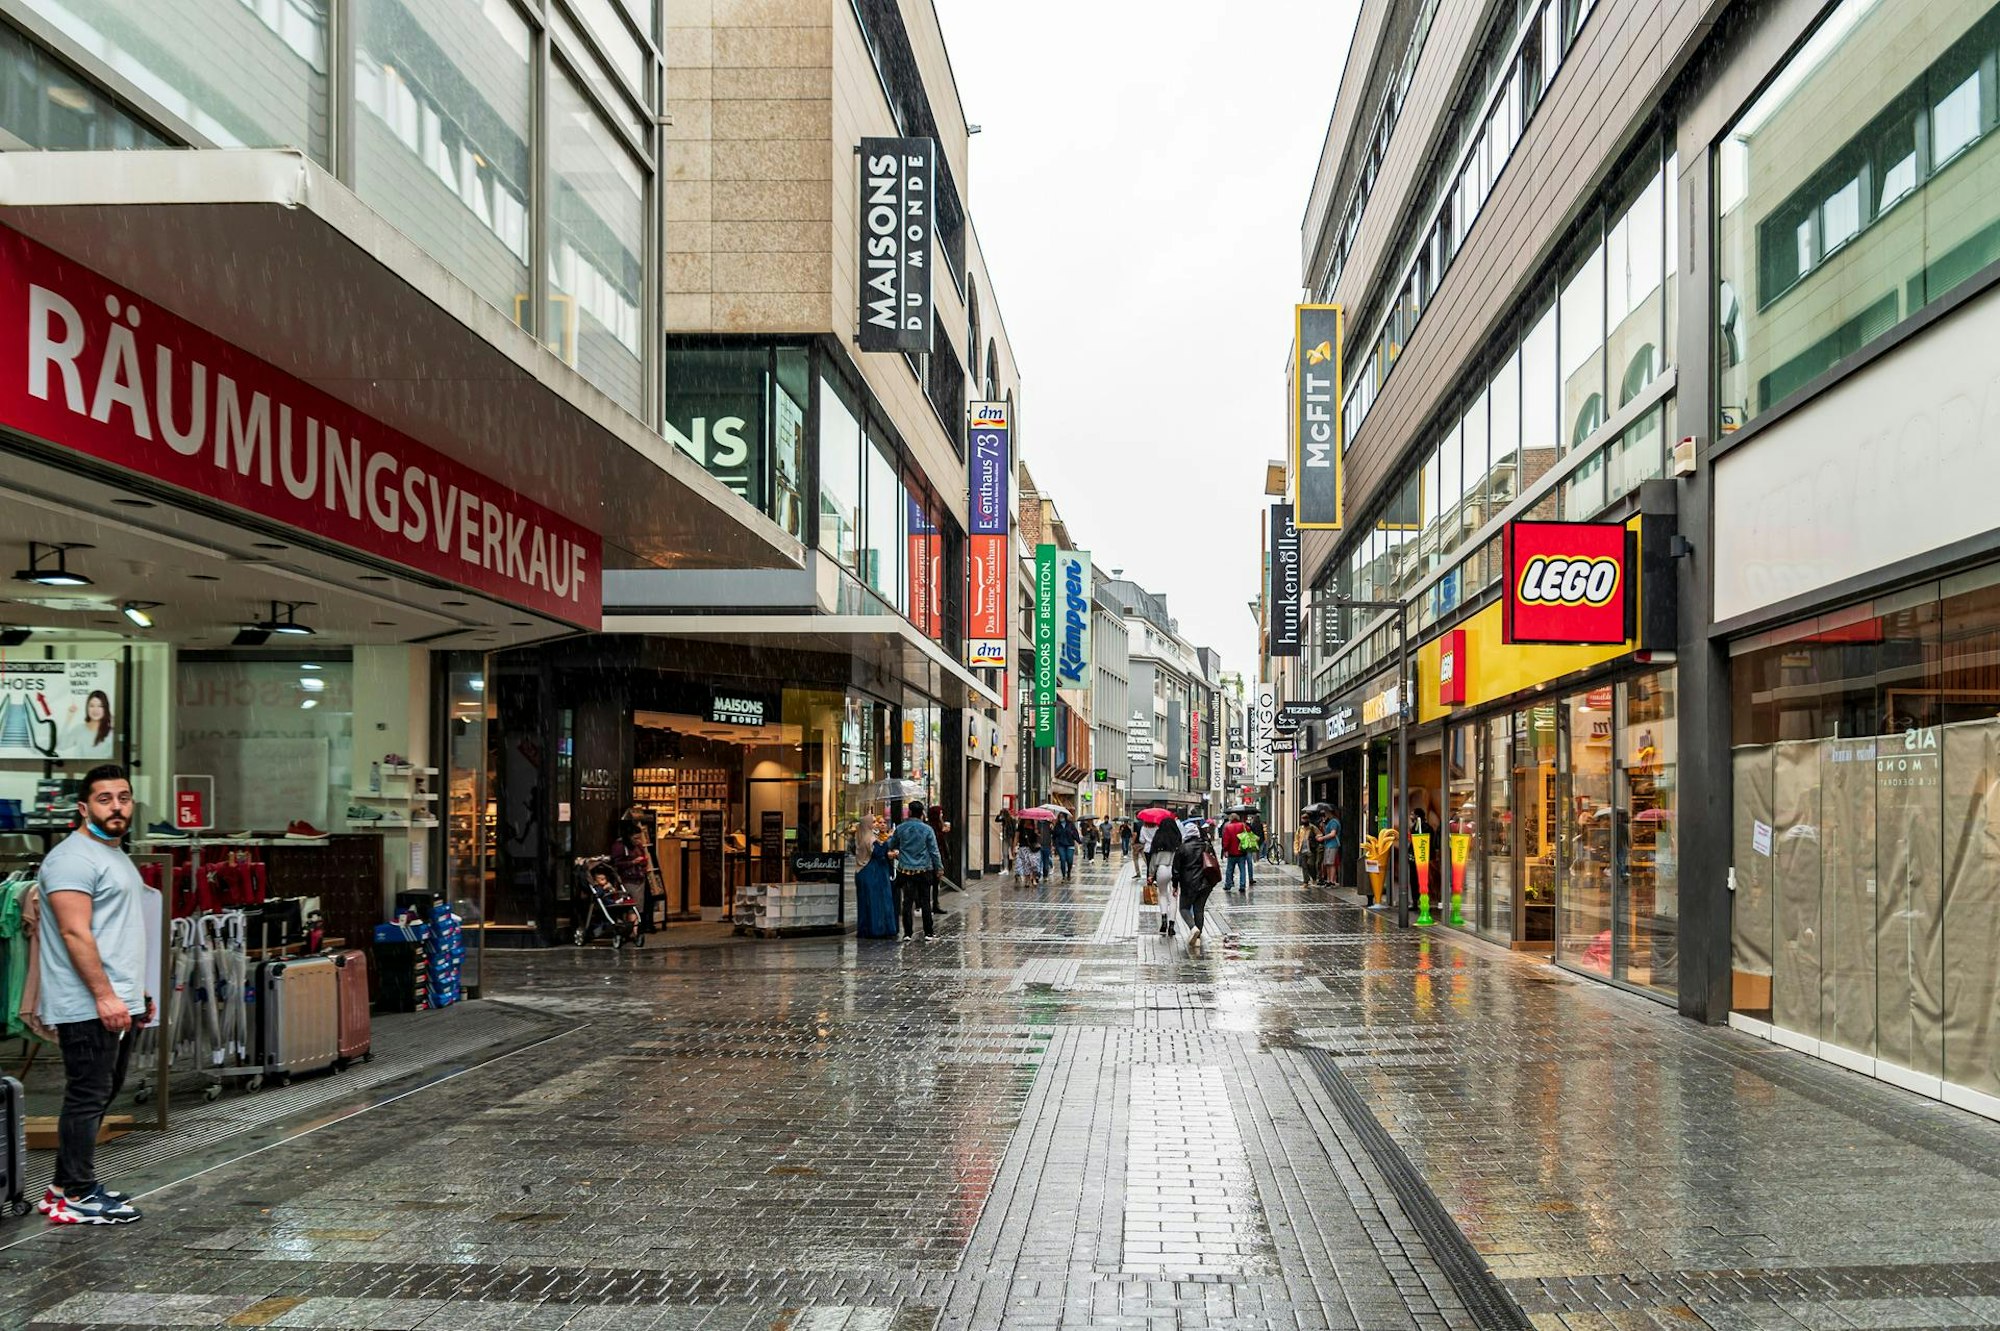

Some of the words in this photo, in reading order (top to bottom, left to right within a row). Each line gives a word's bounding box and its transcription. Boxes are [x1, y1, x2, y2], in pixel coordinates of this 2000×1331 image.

[907, 154, 923, 268] MONDE
[867, 153, 898, 330] MAISONS
[907, 292, 923, 330] DU
[978, 405, 1003, 420] dm
[27, 283, 587, 603] RÄUMUNGSVERKAUF
[977, 434, 999, 459] 73
[979, 460, 993, 529] Eventhaus
[985, 539, 996, 585] Steakhaus
[1277, 516, 1298, 643] hunkemöller
[1521, 558, 1618, 604] LEGO
[985, 587, 995, 613] kleine
[1040, 560, 1051, 618] BENETTON.
[985, 615, 995, 633] Das
[1040, 622, 1051, 638] OF
[1059, 559, 1087, 682] Kämpgen
[977, 642, 1001, 657] dm
[1040, 643, 1051, 688] COLORS
[713, 696, 763, 714] MAISONS
[713, 713, 726, 722] DU
[731, 715, 763, 725] MONDE
[1040, 692, 1051, 731] UNITED
[1260, 693, 1273, 773] MANGO
[1273, 740, 1293, 751] VANS
[796, 857, 841, 871] Geschenkt!
